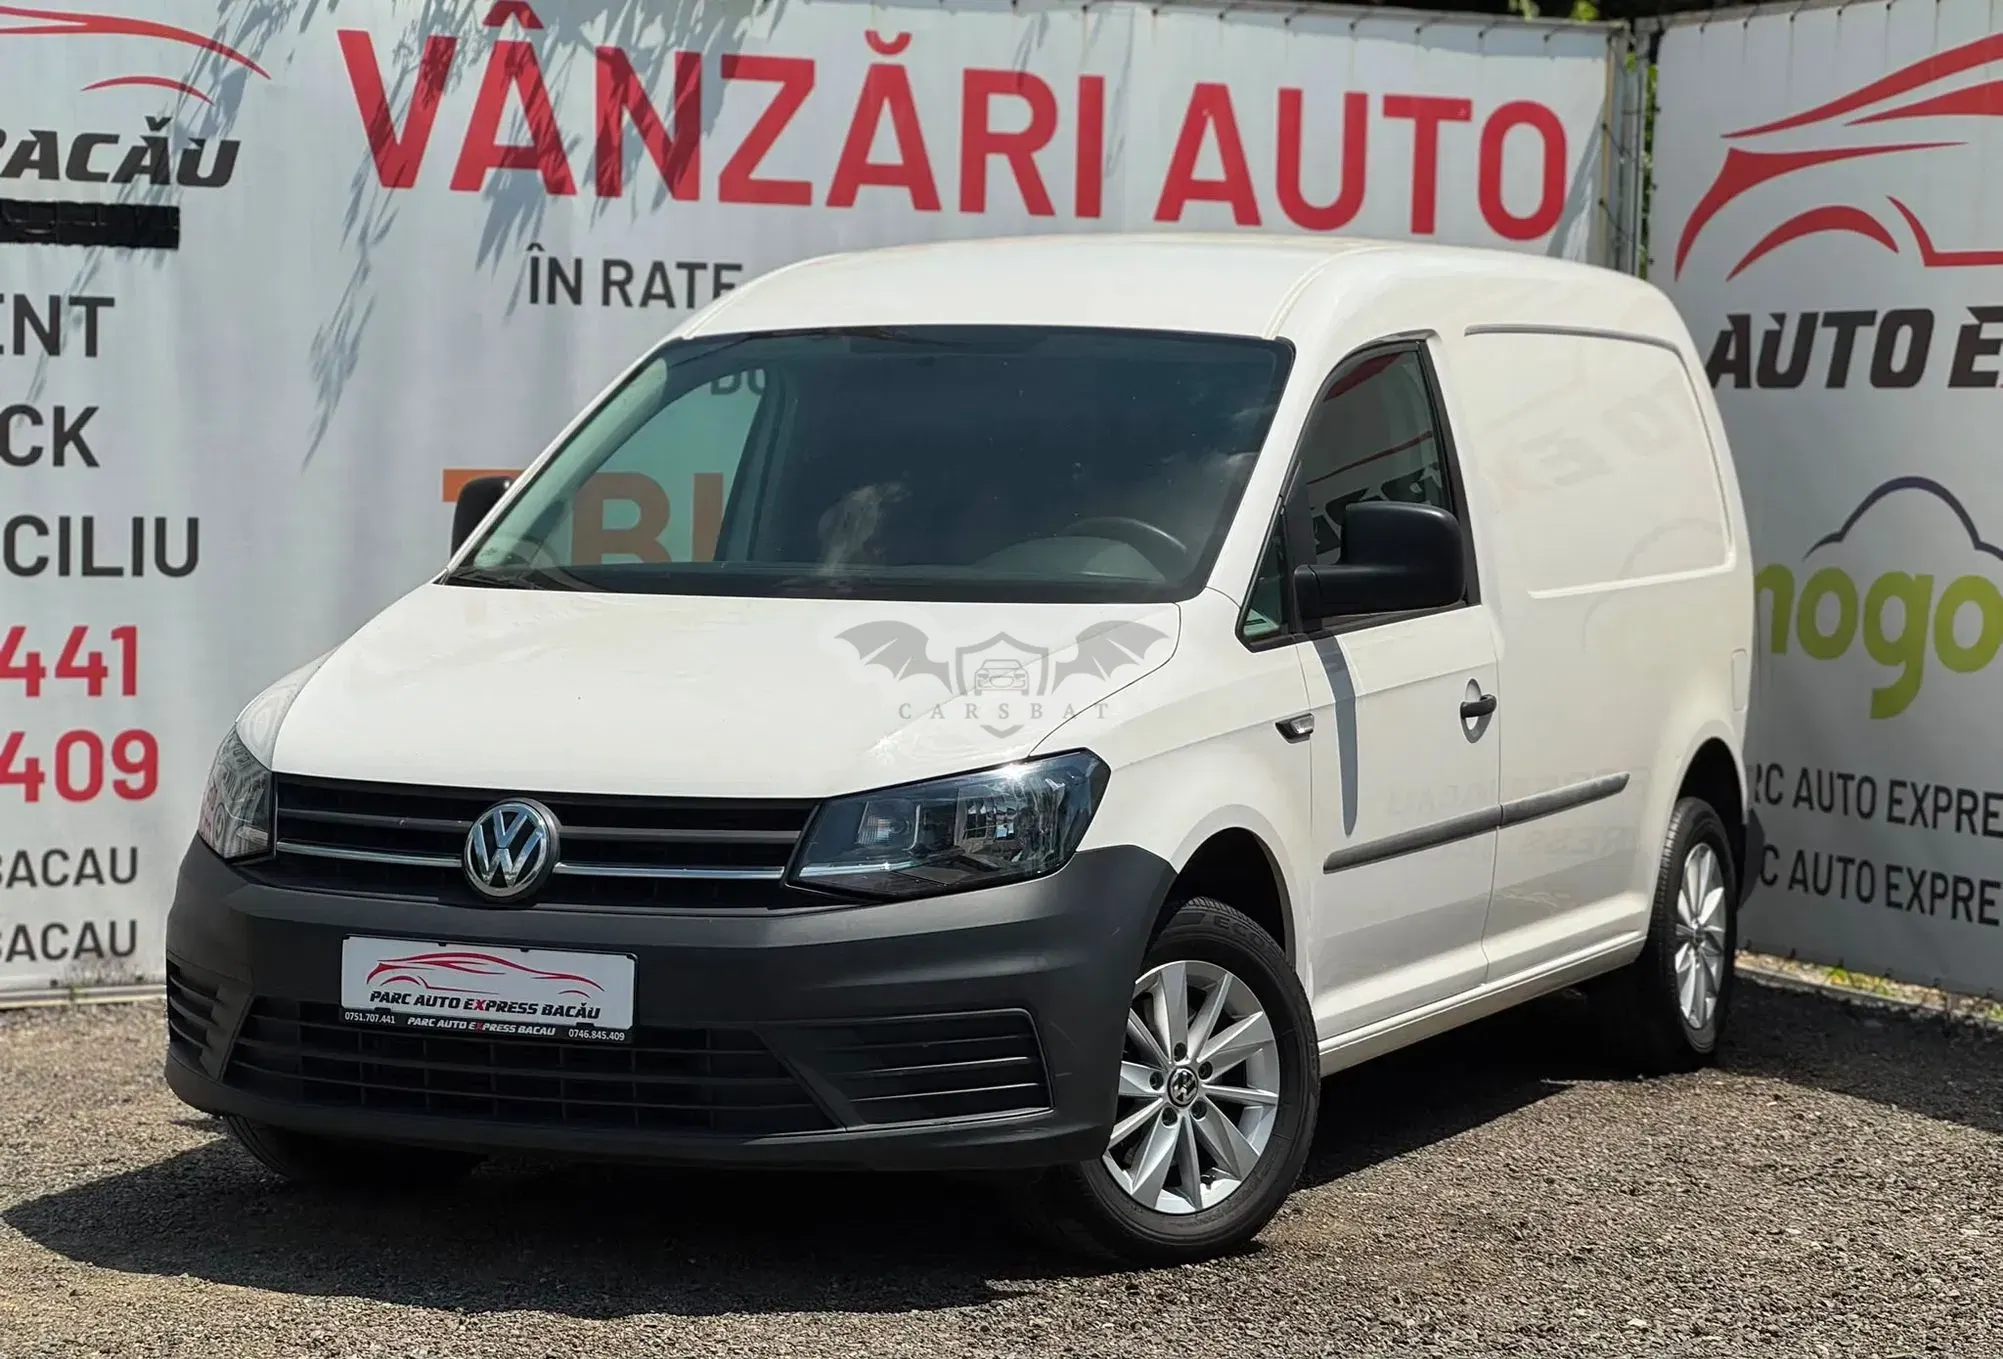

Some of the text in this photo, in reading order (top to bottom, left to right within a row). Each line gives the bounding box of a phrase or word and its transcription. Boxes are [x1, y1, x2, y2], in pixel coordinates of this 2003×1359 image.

[0, 115, 241, 188] ACĂU
[338, 0, 1567, 241] VÂNZĂRI AUTO
[526, 243, 582, 306] ÎN
[0, 293, 116, 358] NT
[1704, 308, 1935, 389] AUTO
[0, 403, 100, 468] CK
[3, 514, 199, 578] CILIU
[0, 625, 138, 697] 441
[0, 729, 158, 803] 409
[1791, 766, 1877, 820] AUTO
[1886, 779, 2003, 838] EXPRE
[0, 846, 138, 889] ACAU
[1787, 849, 1877, 904] AUTO
[1884, 863, 2003, 926] EXPRE
[0, 919, 138, 963] ACAU
[344, 1011, 396, 1025] 0751.707.441
[369, 990, 602, 1020] PARC AUTO EXPRESS BACĂU
[407, 1016, 557, 1037] PARC AUTO EXPRESS BACAU
[568, 1028, 626, 1042] 0746.845.409
